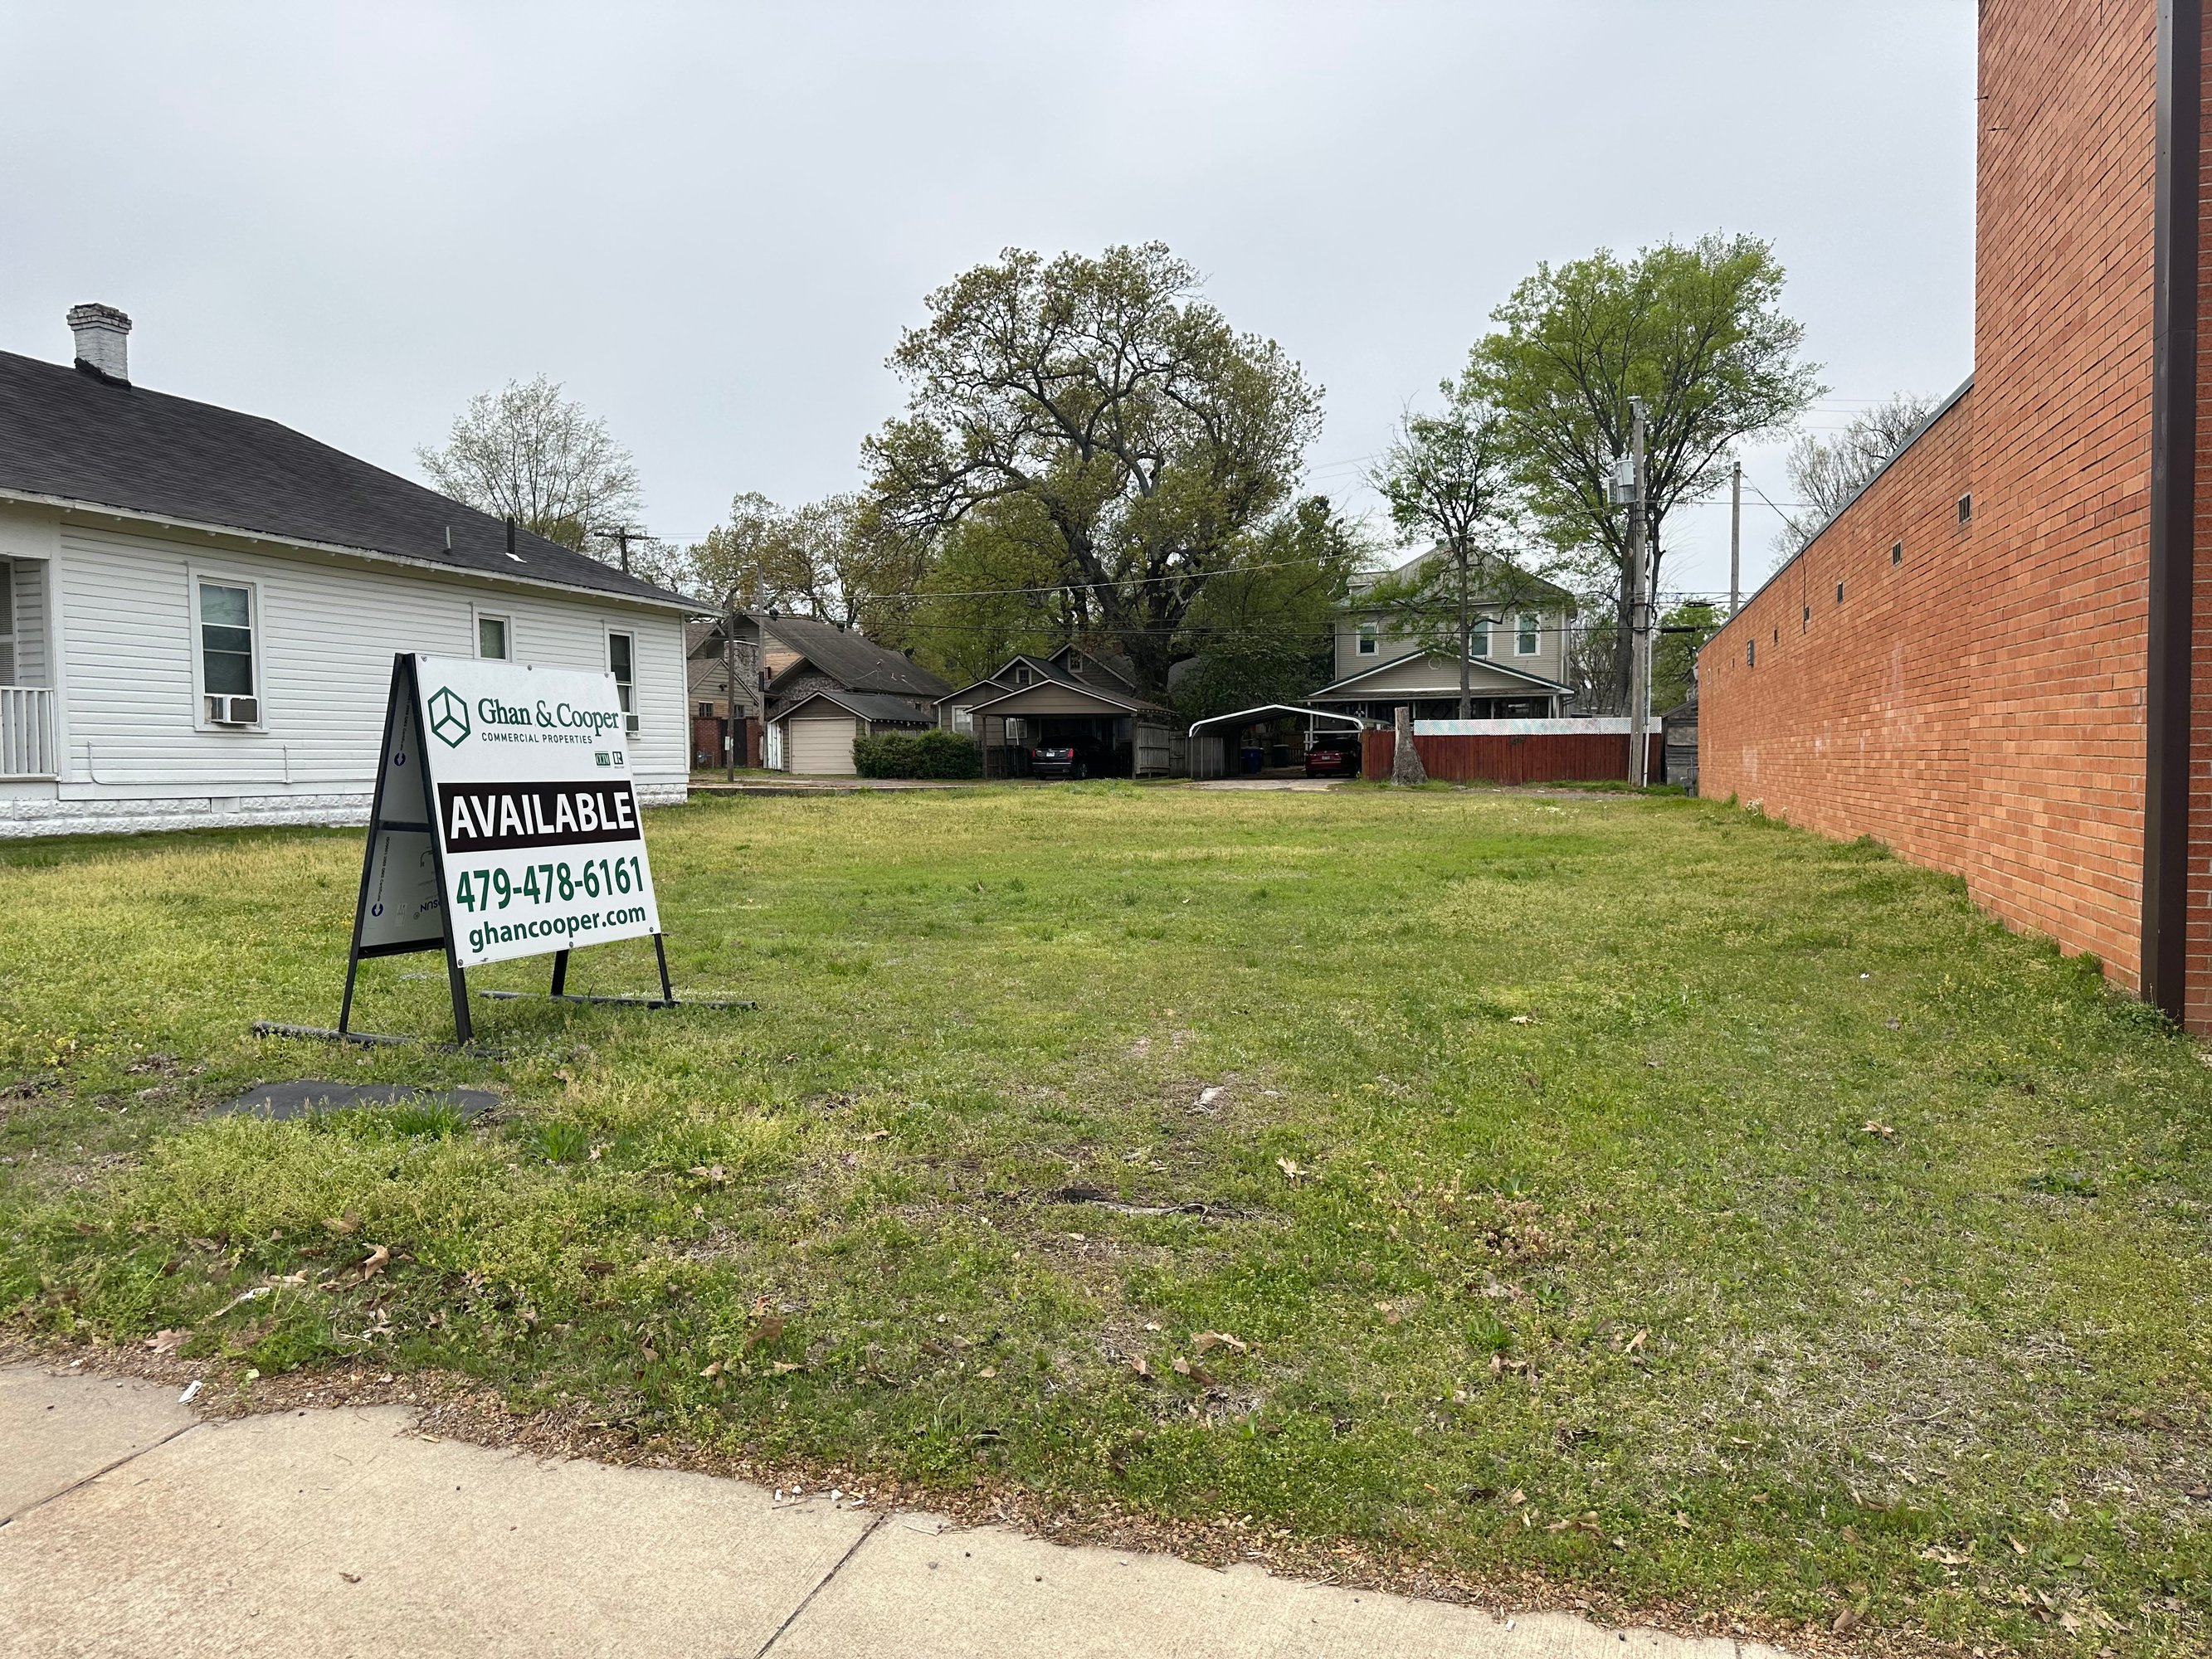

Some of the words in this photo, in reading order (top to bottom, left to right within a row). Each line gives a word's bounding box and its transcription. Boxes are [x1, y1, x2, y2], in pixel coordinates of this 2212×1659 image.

[478, 698, 533, 726] Ghan
[536, 699, 557, 728] &
[556, 703, 620, 737] Cooper
[481, 732, 539, 743] COMMERCIAL
[542, 734, 593, 744] PROPERTIES
[451, 791, 635, 839] AVAILABLE
[456, 855, 644, 912] 479-478-6161
[420, 899, 441, 912] SUN
[468, 906, 646, 953] ghancooper.com
